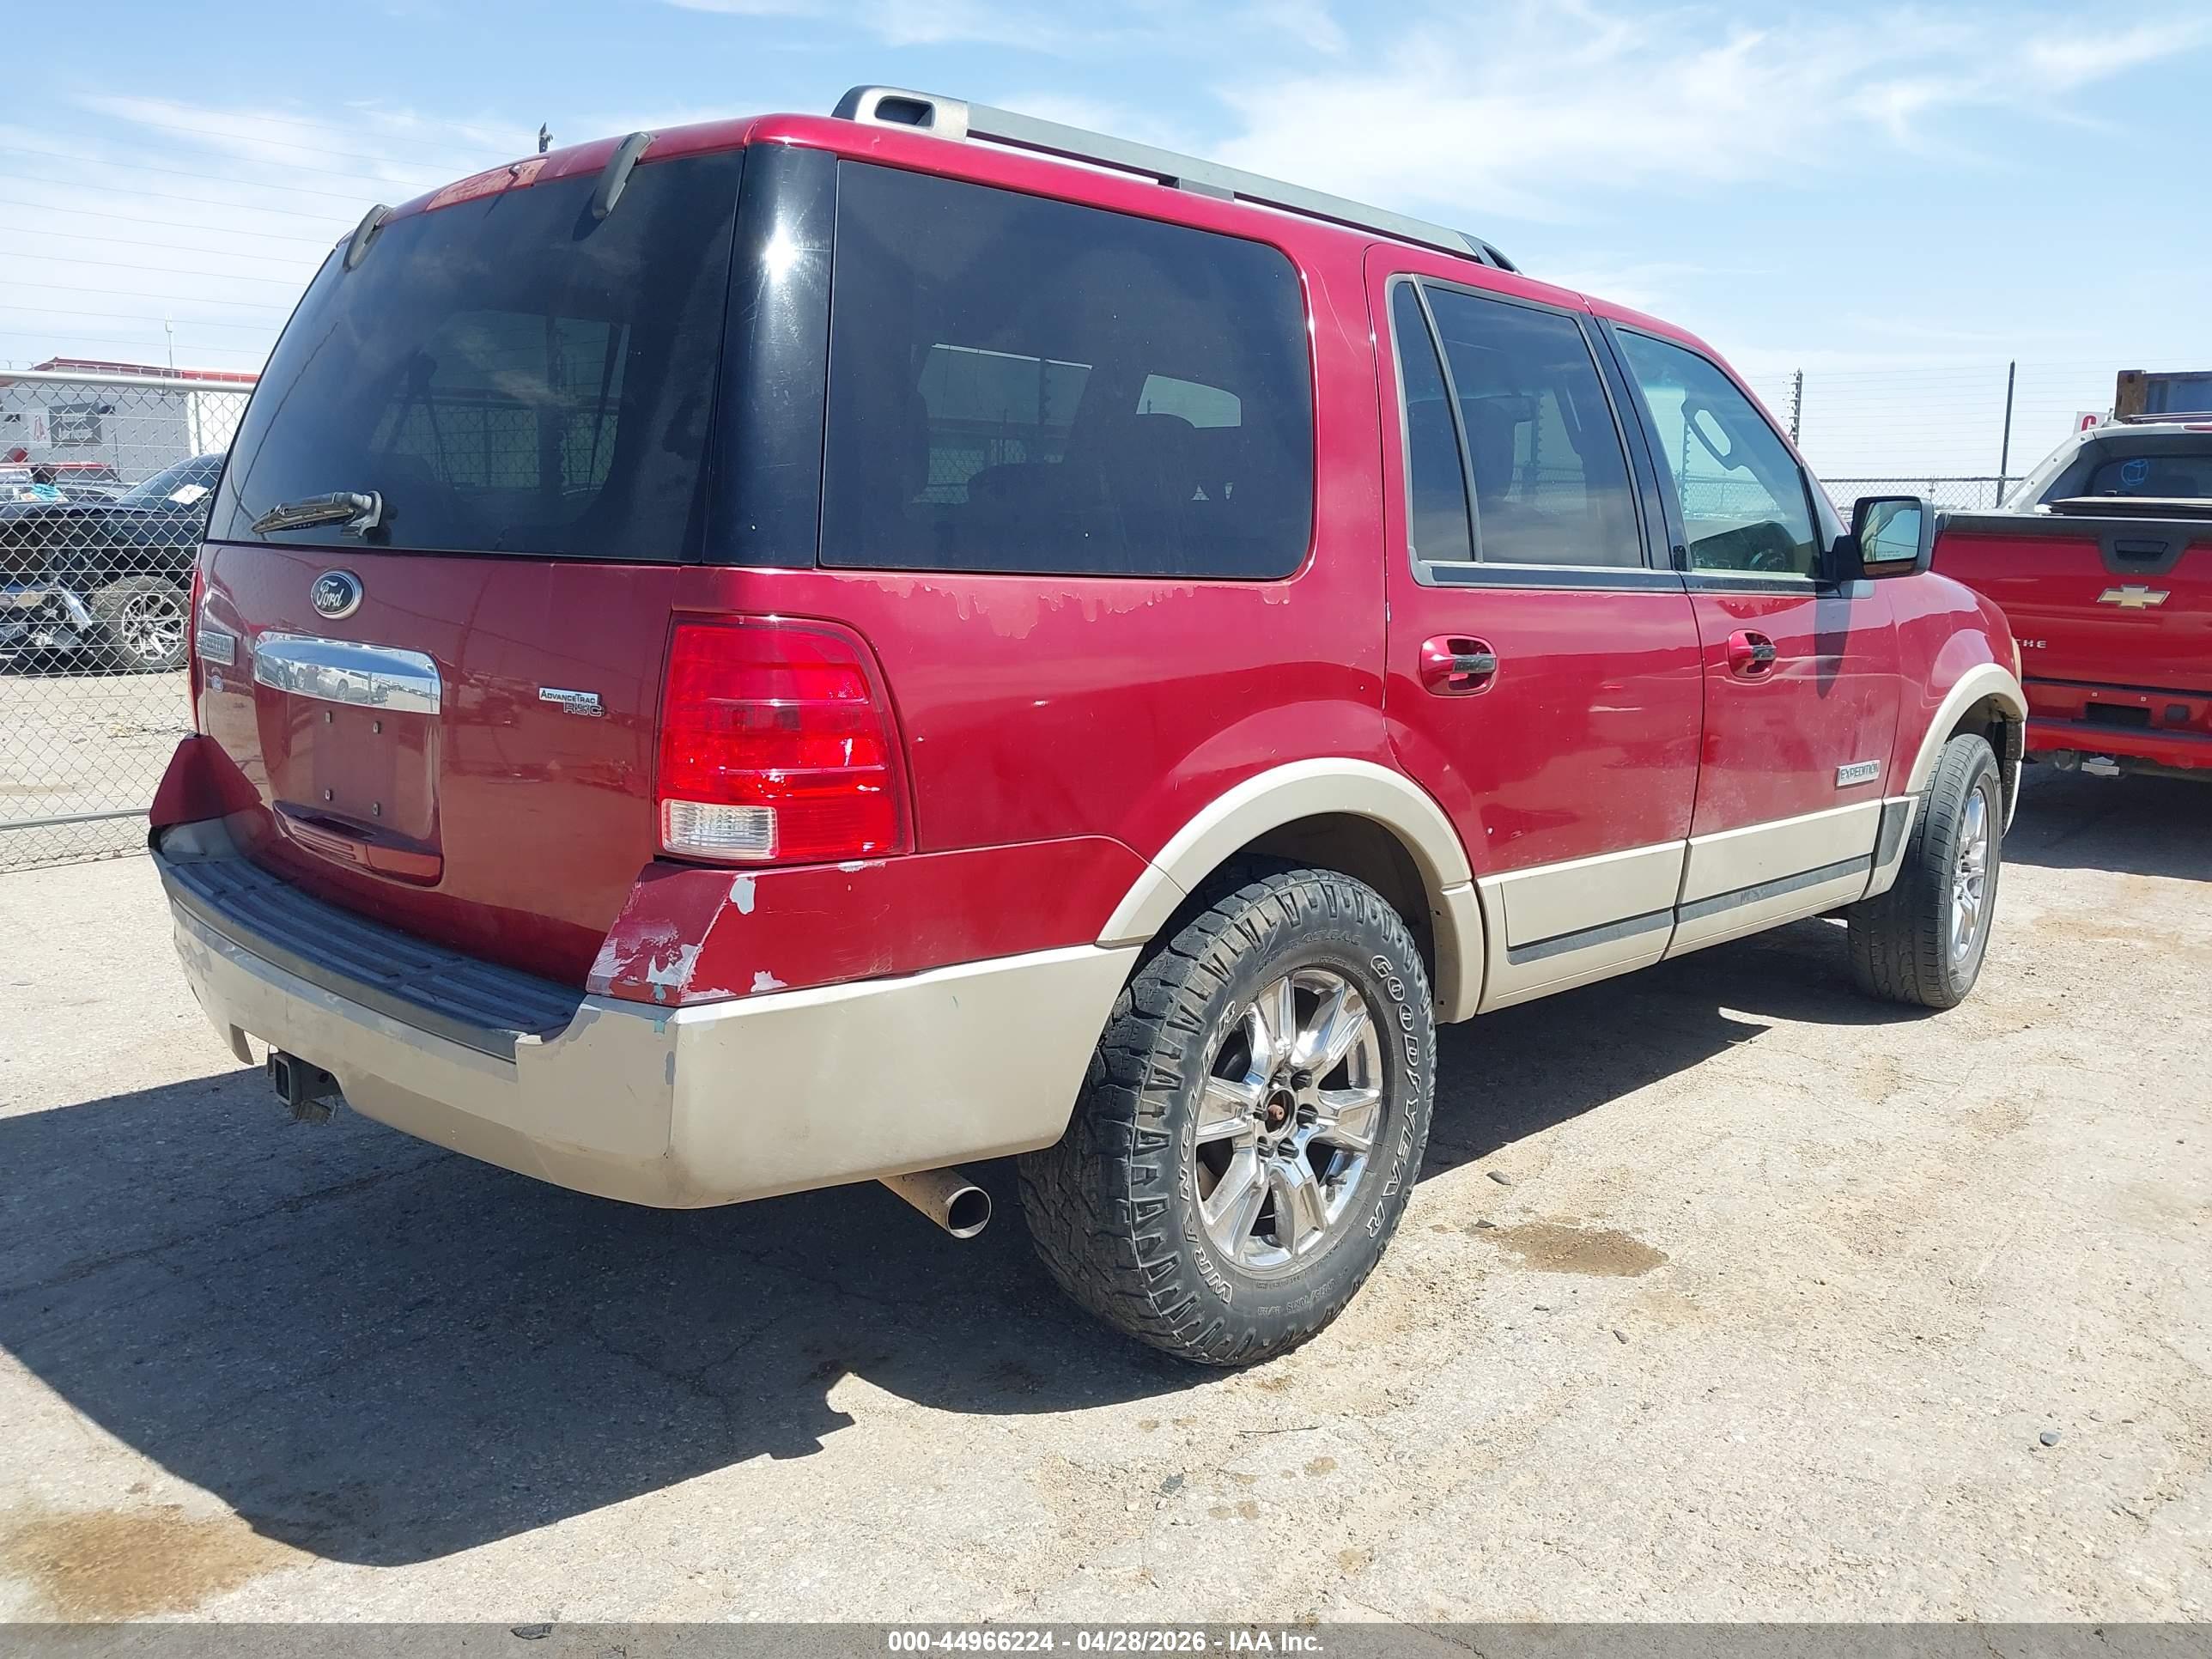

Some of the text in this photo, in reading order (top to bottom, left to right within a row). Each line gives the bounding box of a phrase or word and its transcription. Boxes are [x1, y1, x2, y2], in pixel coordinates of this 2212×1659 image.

[563, 701, 605, 717] RSC
[1178, 1000, 1237, 1304] WRANGLER
[1369, 955, 1419, 1239] GOODYEAR
